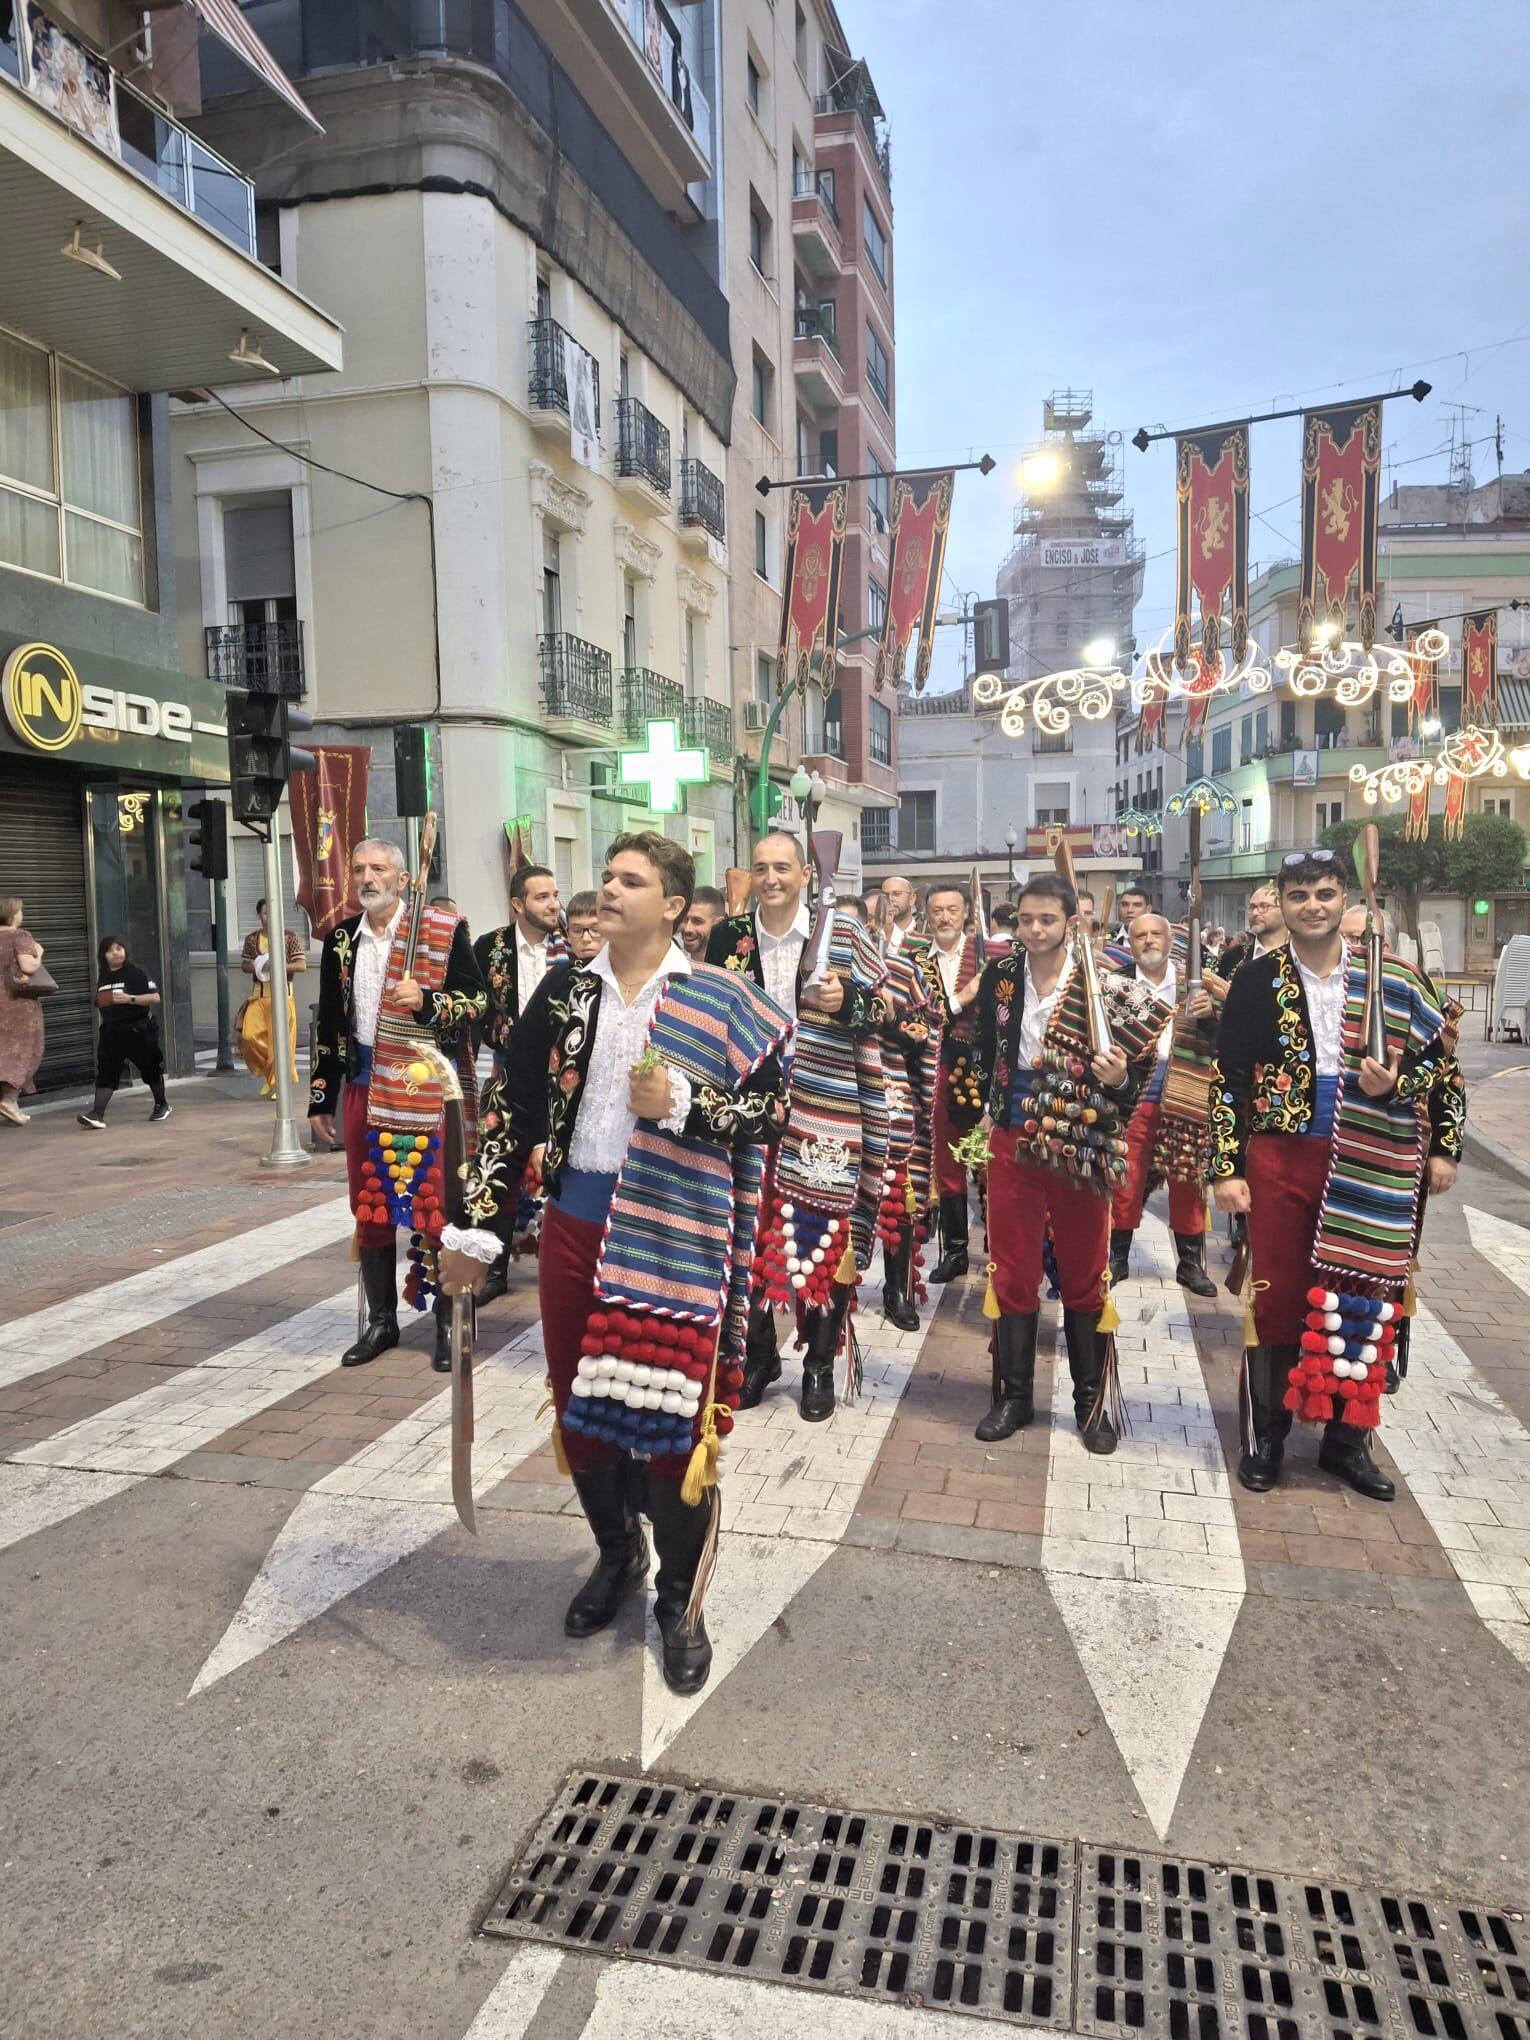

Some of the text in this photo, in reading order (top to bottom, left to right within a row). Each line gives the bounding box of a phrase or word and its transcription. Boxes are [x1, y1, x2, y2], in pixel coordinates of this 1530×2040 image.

[1044, 548, 1072, 565] ENCISO
[1080, 548, 1099, 564] JOSE
[718, 1821, 747, 1869] BENITO.com
[808, 1883, 875, 1902] BENITO
[993, 1861, 1012, 1913] BENITO.com
[916, 1911, 937, 1975] BENITO.com
[1222, 1959, 1240, 2022] BENITO.com
